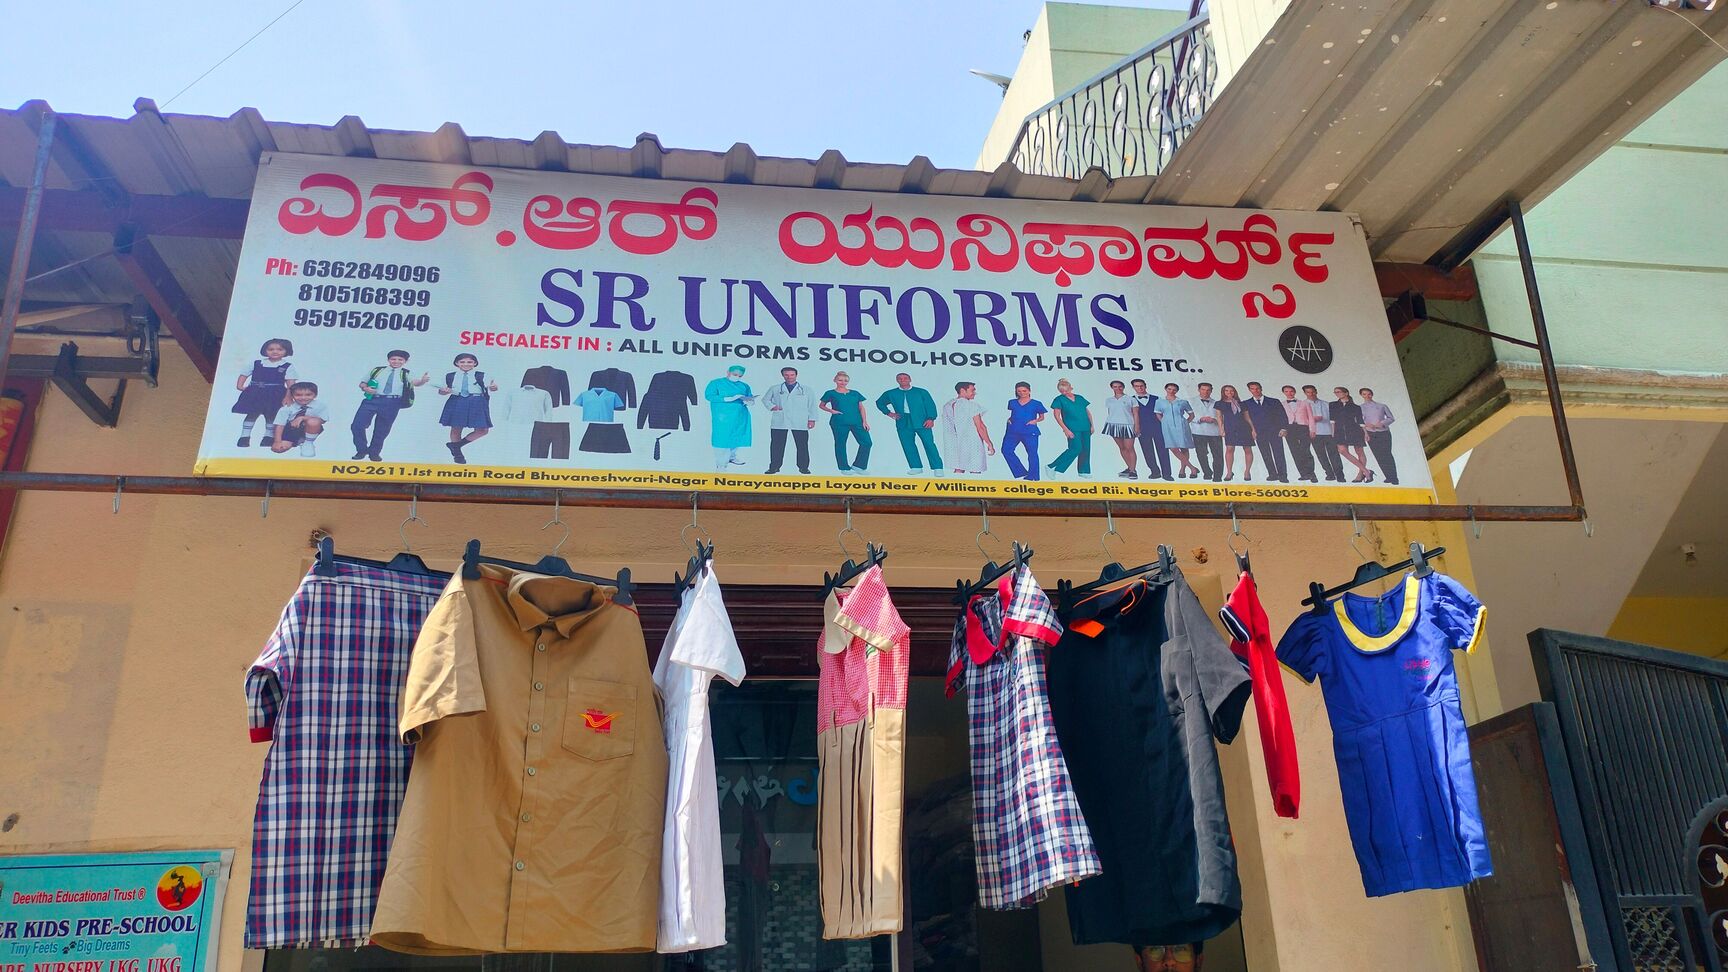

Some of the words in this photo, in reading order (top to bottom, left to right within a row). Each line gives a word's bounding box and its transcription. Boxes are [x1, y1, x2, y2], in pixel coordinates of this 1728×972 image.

[265, 257, 298, 276] Ph:
[302, 259, 440, 284] 6362849096
[298, 284, 431, 307] 8105168399
[293, 308, 431, 332] 9591526040
[536, 267, 656, 332] SR
[678, 275, 1135, 350] UNIFORMS
[459, 330, 572, 351] SPECIALEST
[577, 336, 600, 352] IN
[618, 338, 664, 355] ALL
[671, 341, 810, 361] UNIFORMS
[1151, 358, 1204, 374] ETC..
[437, 468, 478, 478] main
[483, 470, 525, 480] Road
[530, 471, 708, 486] Bhuvaneshwari-Nagar
[714, 477, 821, 490] Narayanappa
[825, 480, 877, 491] Layout
[881, 481, 918, 491] Near
[935, 482, 997, 493] Williams
[1003, 484, 1054, 496] college
[1060, 486, 1098, 495] Road
[1128, 486, 1174, 498] Nagar
[1179, 488, 1208, 498] post
[1213, 488, 1309, 498] B'lore-560032
[12, 891, 53, 905] Deevitha
[55, 889, 111, 903] Educational
[113, 888, 137, 901] Trust
[23, 919, 70, 939] KIDS
[75, 916, 197, 937] PRE-SCHOOL
[10, 941, 31, 958] Tiny
[32, 941, 59, 954] Feets
[76, 939, 93, 955] Big
[94, 938, 131, 952] Dreams
